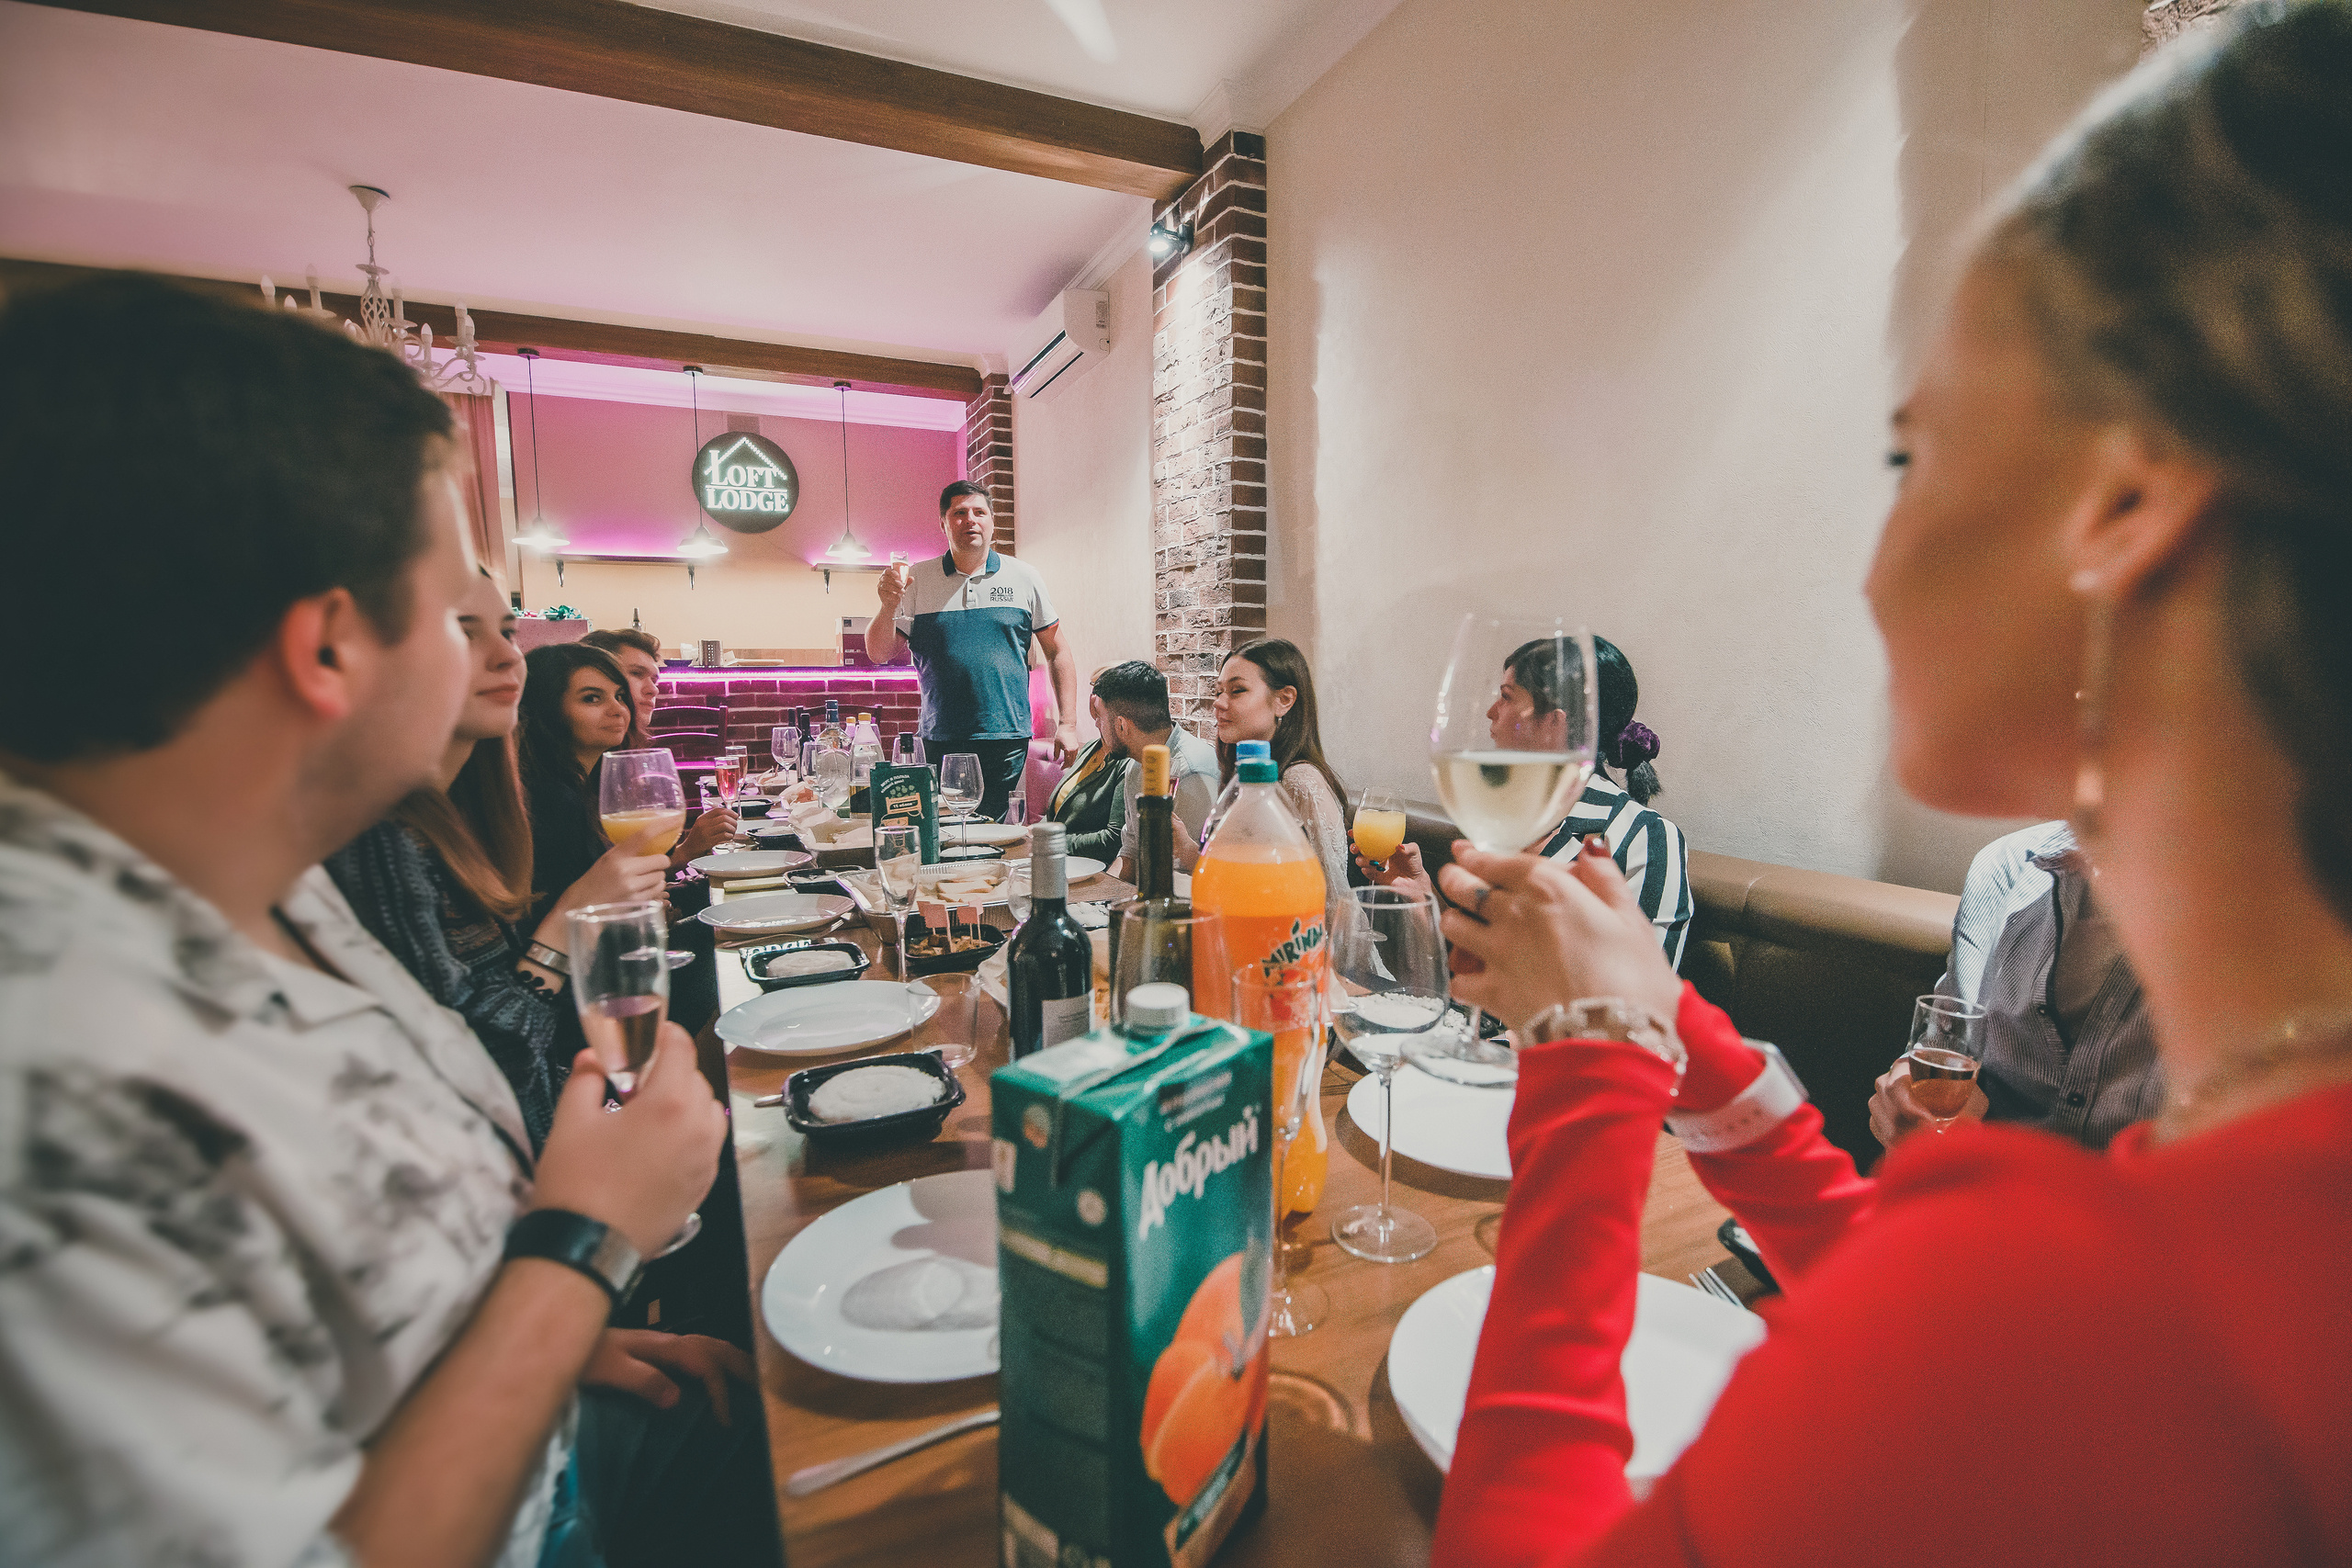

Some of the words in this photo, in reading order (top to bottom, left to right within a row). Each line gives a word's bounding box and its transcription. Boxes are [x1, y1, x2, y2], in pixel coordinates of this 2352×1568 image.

[708, 450, 777, 488] LOFT
[707, 489, 789, 512] LODGE
[990, 586, 1013, 594] 2018
[1138, 1105, 1259, 1240] Добрый
